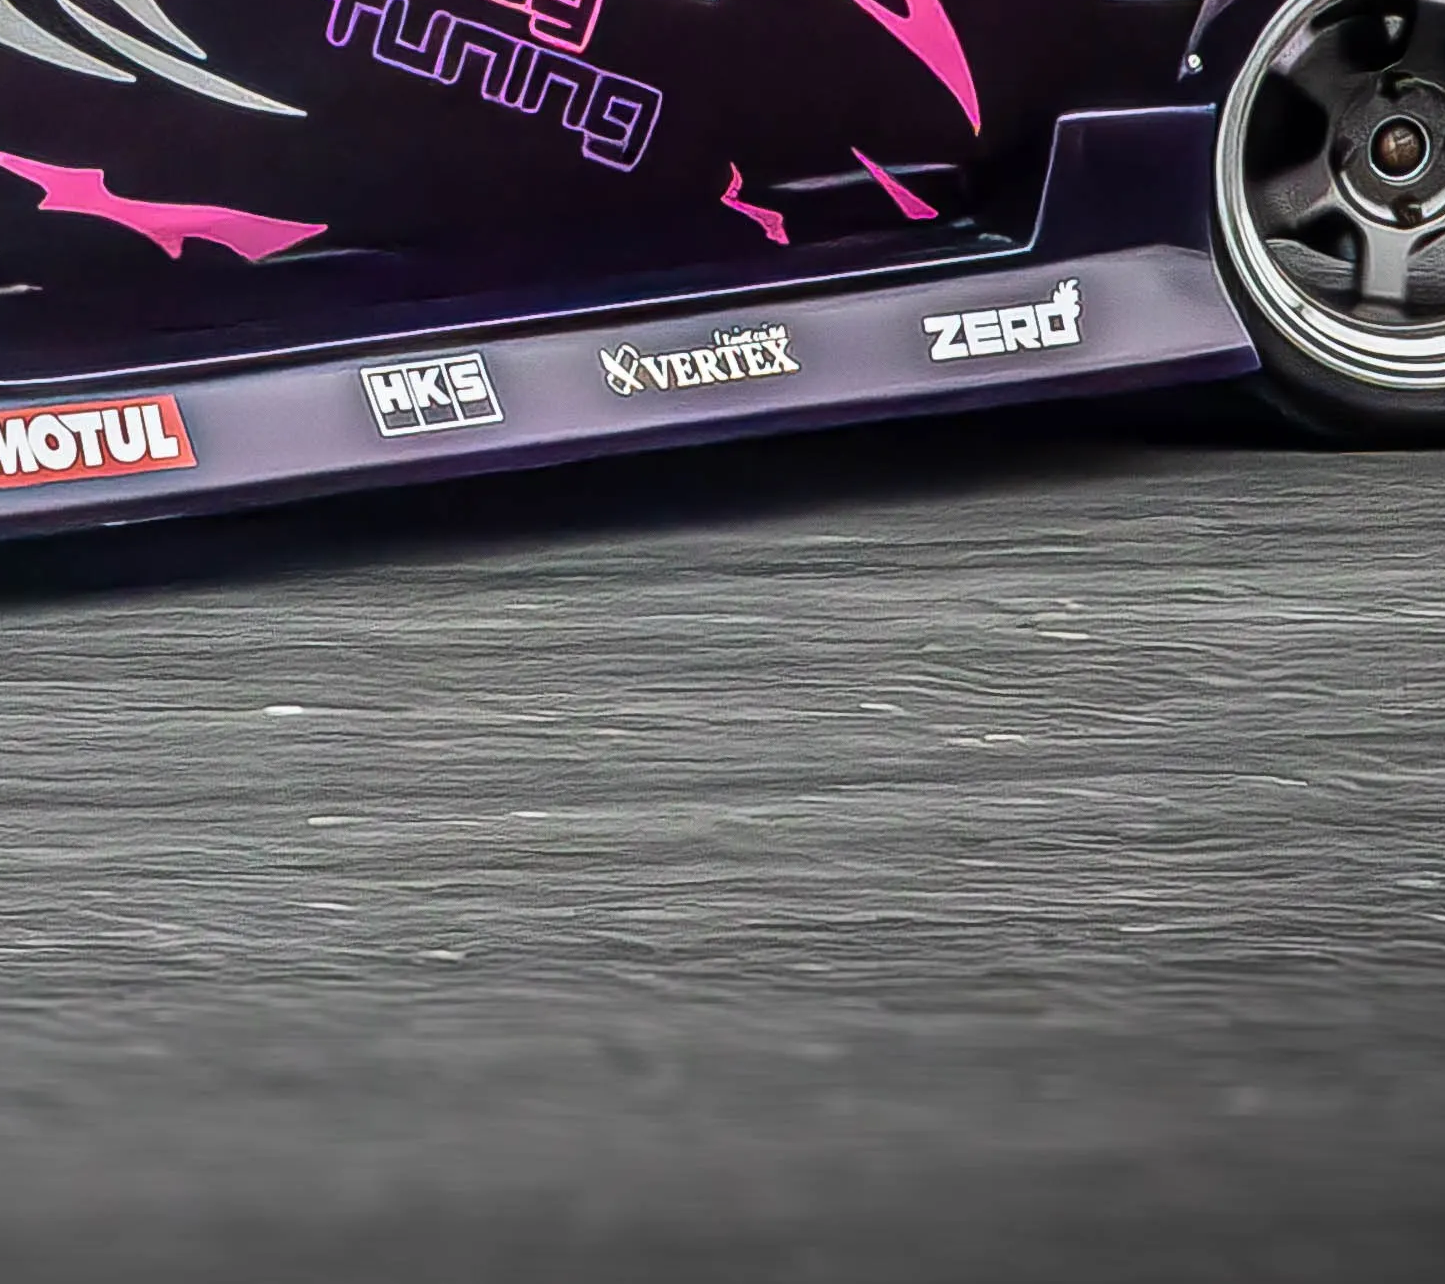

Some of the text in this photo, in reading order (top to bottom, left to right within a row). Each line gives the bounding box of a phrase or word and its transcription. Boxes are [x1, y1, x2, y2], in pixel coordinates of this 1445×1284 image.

[922, 290, 1082, 362] ZERO
[368, 359, 489, 415] HKS
[638, 338, 801, 392] VERTEX
